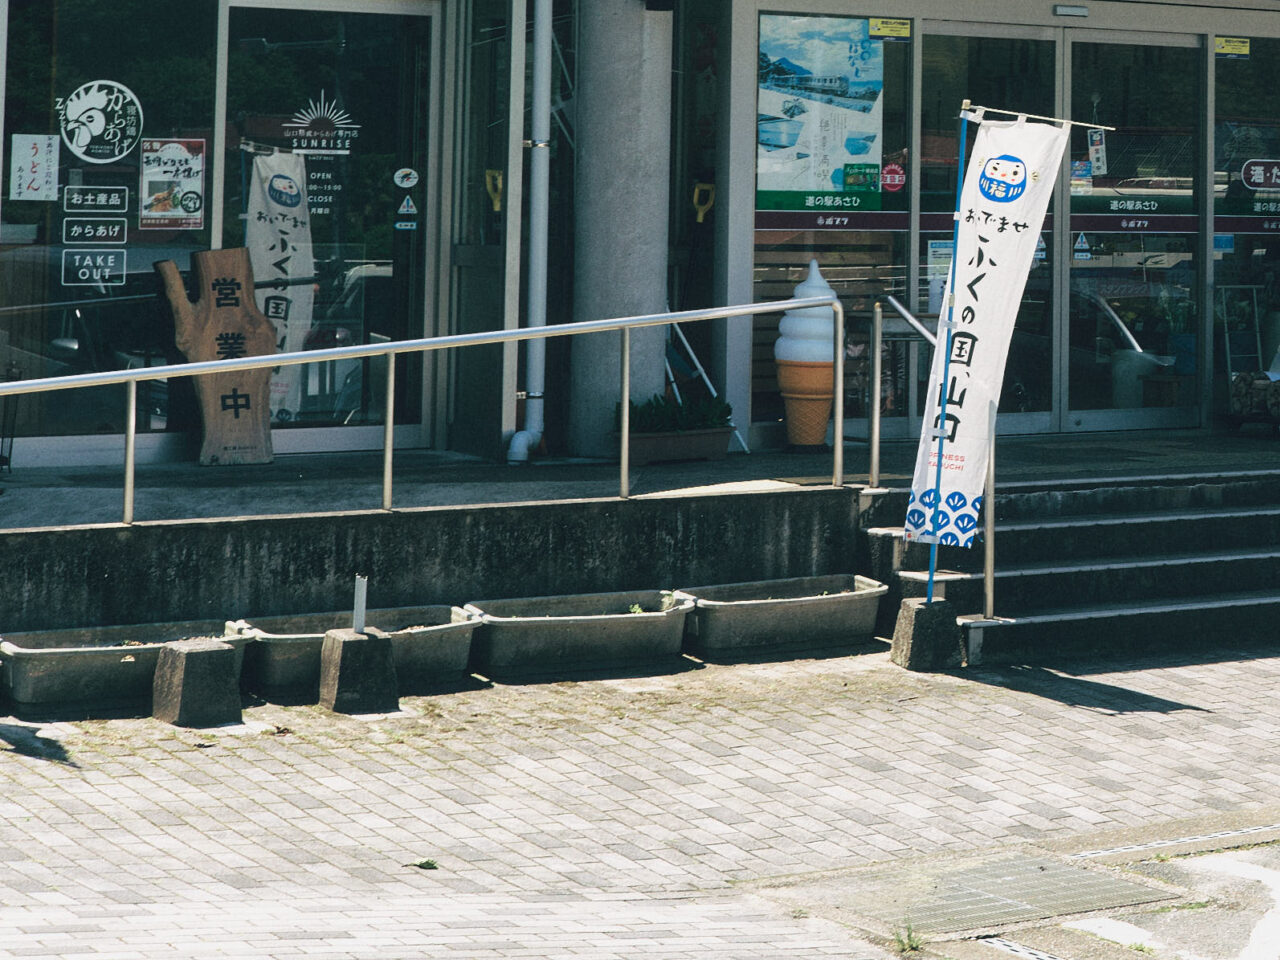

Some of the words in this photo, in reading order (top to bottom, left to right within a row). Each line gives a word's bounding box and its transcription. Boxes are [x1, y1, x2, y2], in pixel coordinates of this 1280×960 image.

[292, 138, 351, 149] SUNRISE
[27, 142, 41, 192] うどん
[310, 172, 332, 180] OPEN
[988, 181, 1007, 198] 福
[71, 193, 122, 206] お土産品
[308, 195, 333, 203] CLOSE
[805, 195, 861, 208] 道の駅あさひ
[1109, 200, 1158, 211] 道の駅あさひ
[71, 226, 121, 238] からあげ
[74, 255, 116, 267] TAKE
[78, 268, 111, 281] OUT
[211, 277, 251, 419] 営業中
